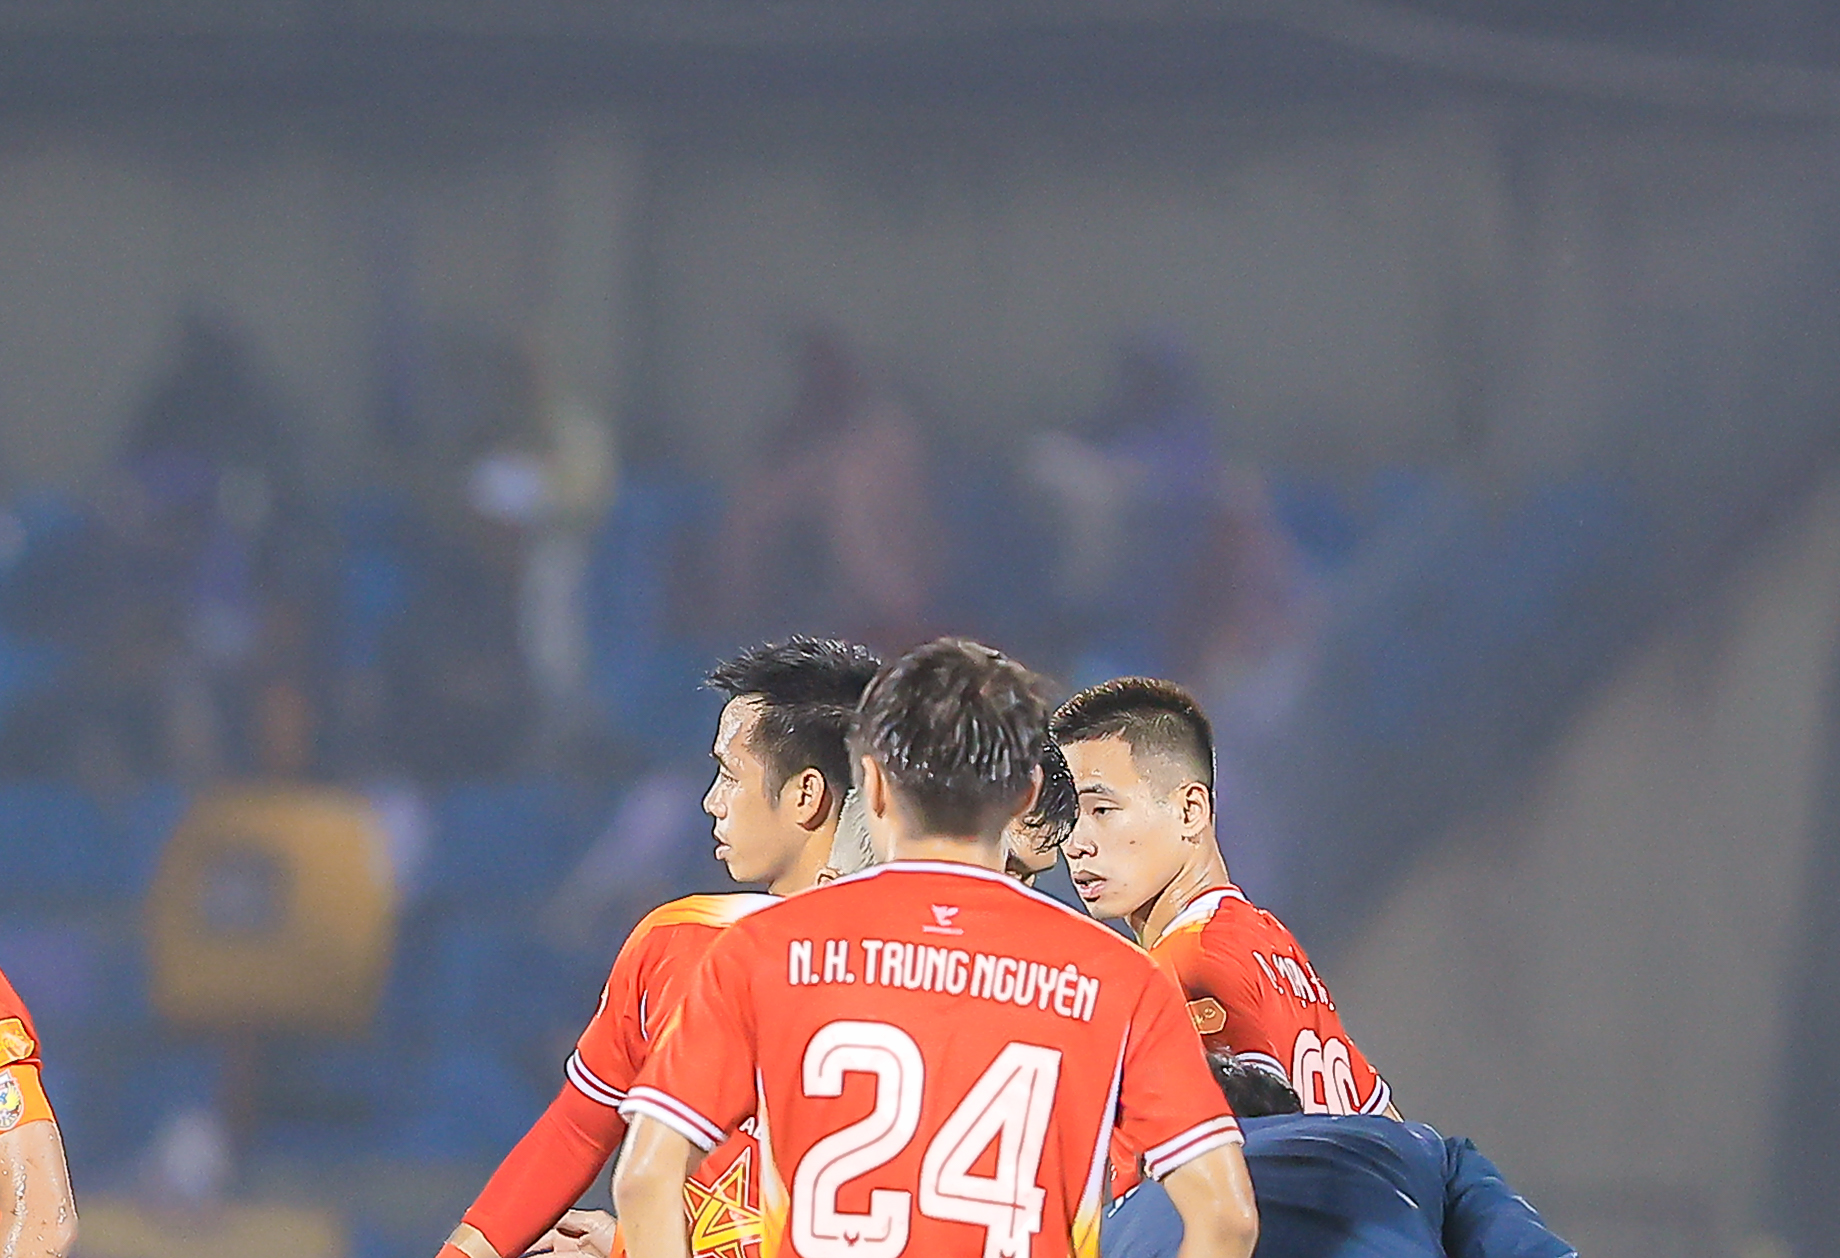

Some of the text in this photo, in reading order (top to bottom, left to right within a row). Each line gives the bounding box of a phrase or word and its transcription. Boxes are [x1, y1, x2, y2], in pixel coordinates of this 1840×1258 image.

[788, 938, 1100, 1022] N. H. TRUNG NGUYÊN
